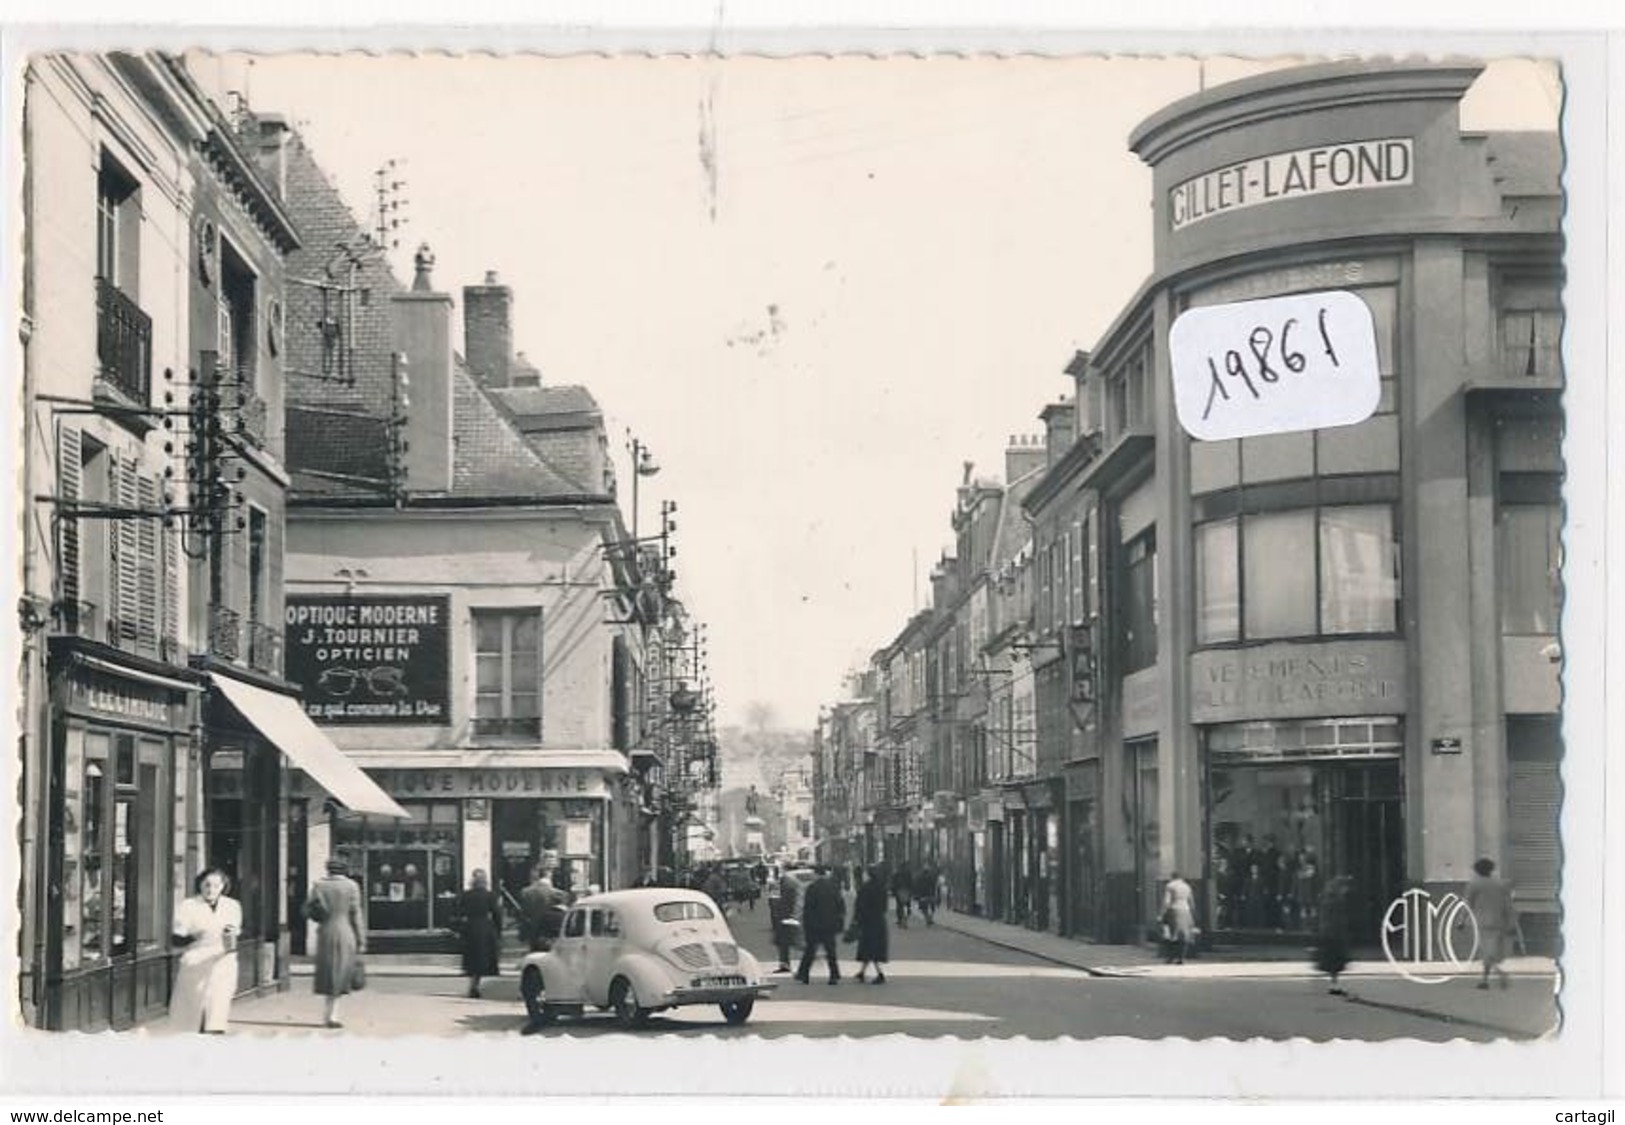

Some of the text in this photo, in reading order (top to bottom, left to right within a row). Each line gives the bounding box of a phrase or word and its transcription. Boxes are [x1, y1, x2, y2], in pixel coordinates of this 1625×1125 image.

[1173, 142, 1409, 226] GILLET-LAFOND
[1203, 308, 1340, 420] 19861
[285, 605, 440, 626] OPTIQUE MODERNE
[316, 648, 410, 661] OPTICIEN
[1208, 655, 1367, 686] VEEMENTS
[324, 702, 345, 719] qui
[467, 769, 590, 792] MODERNE
